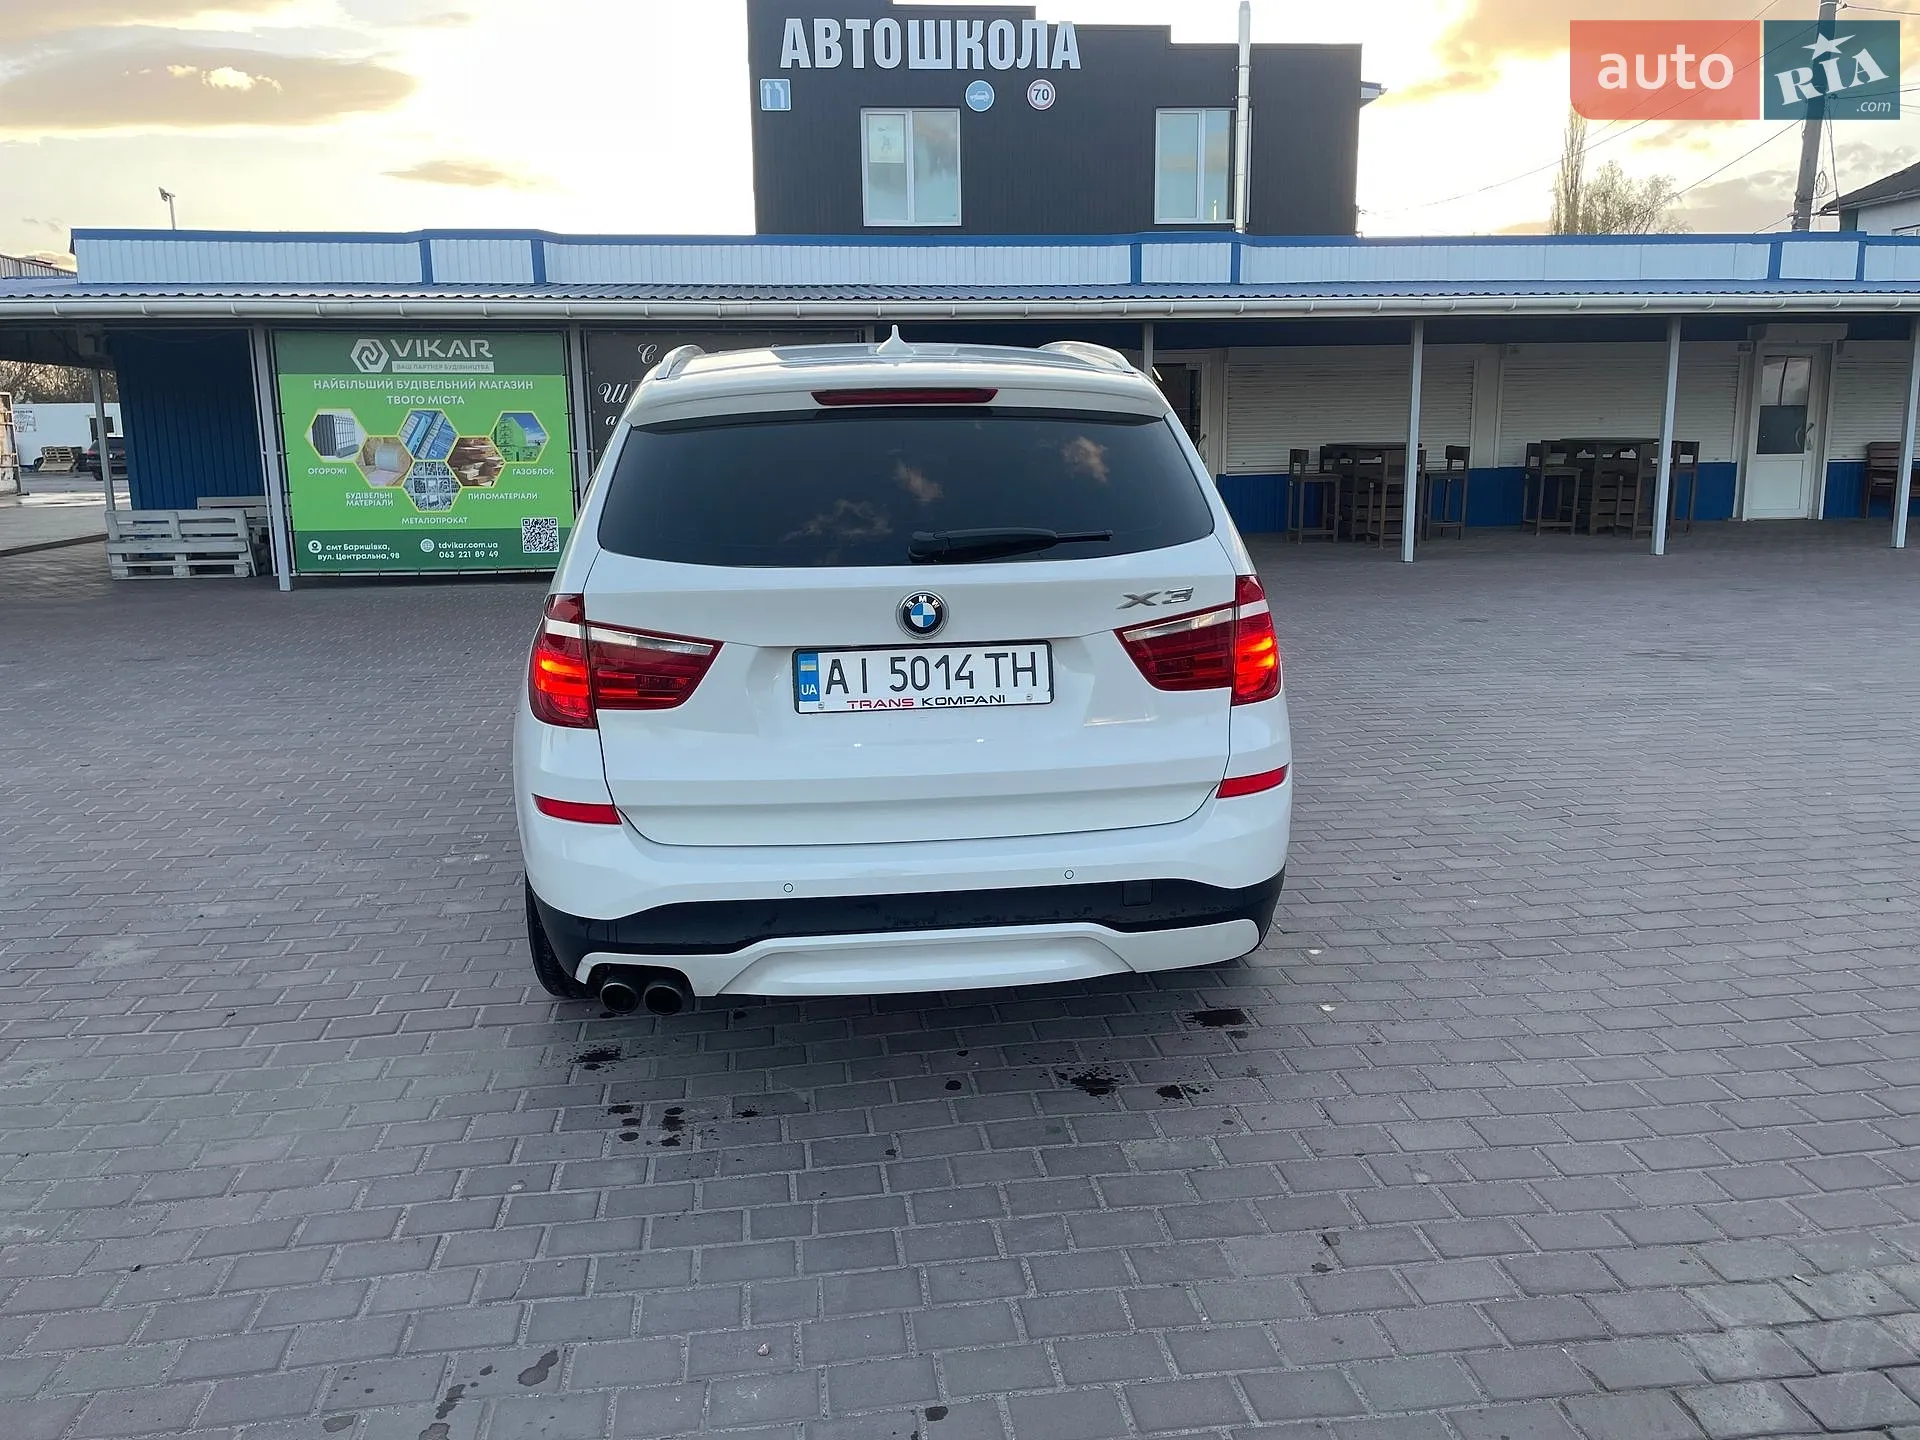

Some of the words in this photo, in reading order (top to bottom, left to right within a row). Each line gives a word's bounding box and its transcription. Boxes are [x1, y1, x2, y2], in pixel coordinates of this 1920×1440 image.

[779, 17, 1082, 70] АВТОШКОЛА
[1033, 86, 1050, 102] 70
[390, 338, 494, 359] VIKAR
[313, 378, 394, 390] НАЙБІЛЬШИЙ
[397, 379, 477, 391] БУДІВЕЛЬНИЙ
[479, 380, 534, 390] МАГАЗИН
[387, 395, 425, 405] ТВОГО
[428, 395, 465, 405] МІСТА
[307, 467, 348, 475] ОГОРОЖІ
[512, 467, 555, 476] ГАЗОБЛОК
[345, 491, 394, 500] БУДІВЕЛЬНІ
[467, 491, 539, 501] ПИЛОМАТЕРІАЛИ
[345, 499, 395, 507] МАТЕРІАЛИ
[400, 516, 469, 526] МЕТАЛОПРОКАТ
[343, 542, 391, 552] Баришівка,
[438, 541, 499, 550] tdvikar.com.ua
[317, 553, 334, 562] вул.
[335, 552, 389, 561] Центральна,
[438, 550, 455, 559] 063
[458, 550, 471, 559] 221
[474, 550, 486, 559] 89
[488, 550, 499, 559] 49
[905, 594, 941, 610] BMW
[1116, 586, 1194, 610] X3
[889, 653, 975, 692] 5014
[984, 651, 1038, 689] TH
[801, 683, 818, 696] UA
[846, 697, 915, 710] TRANS
[921, 694, 1007, 707] KOMPANI
